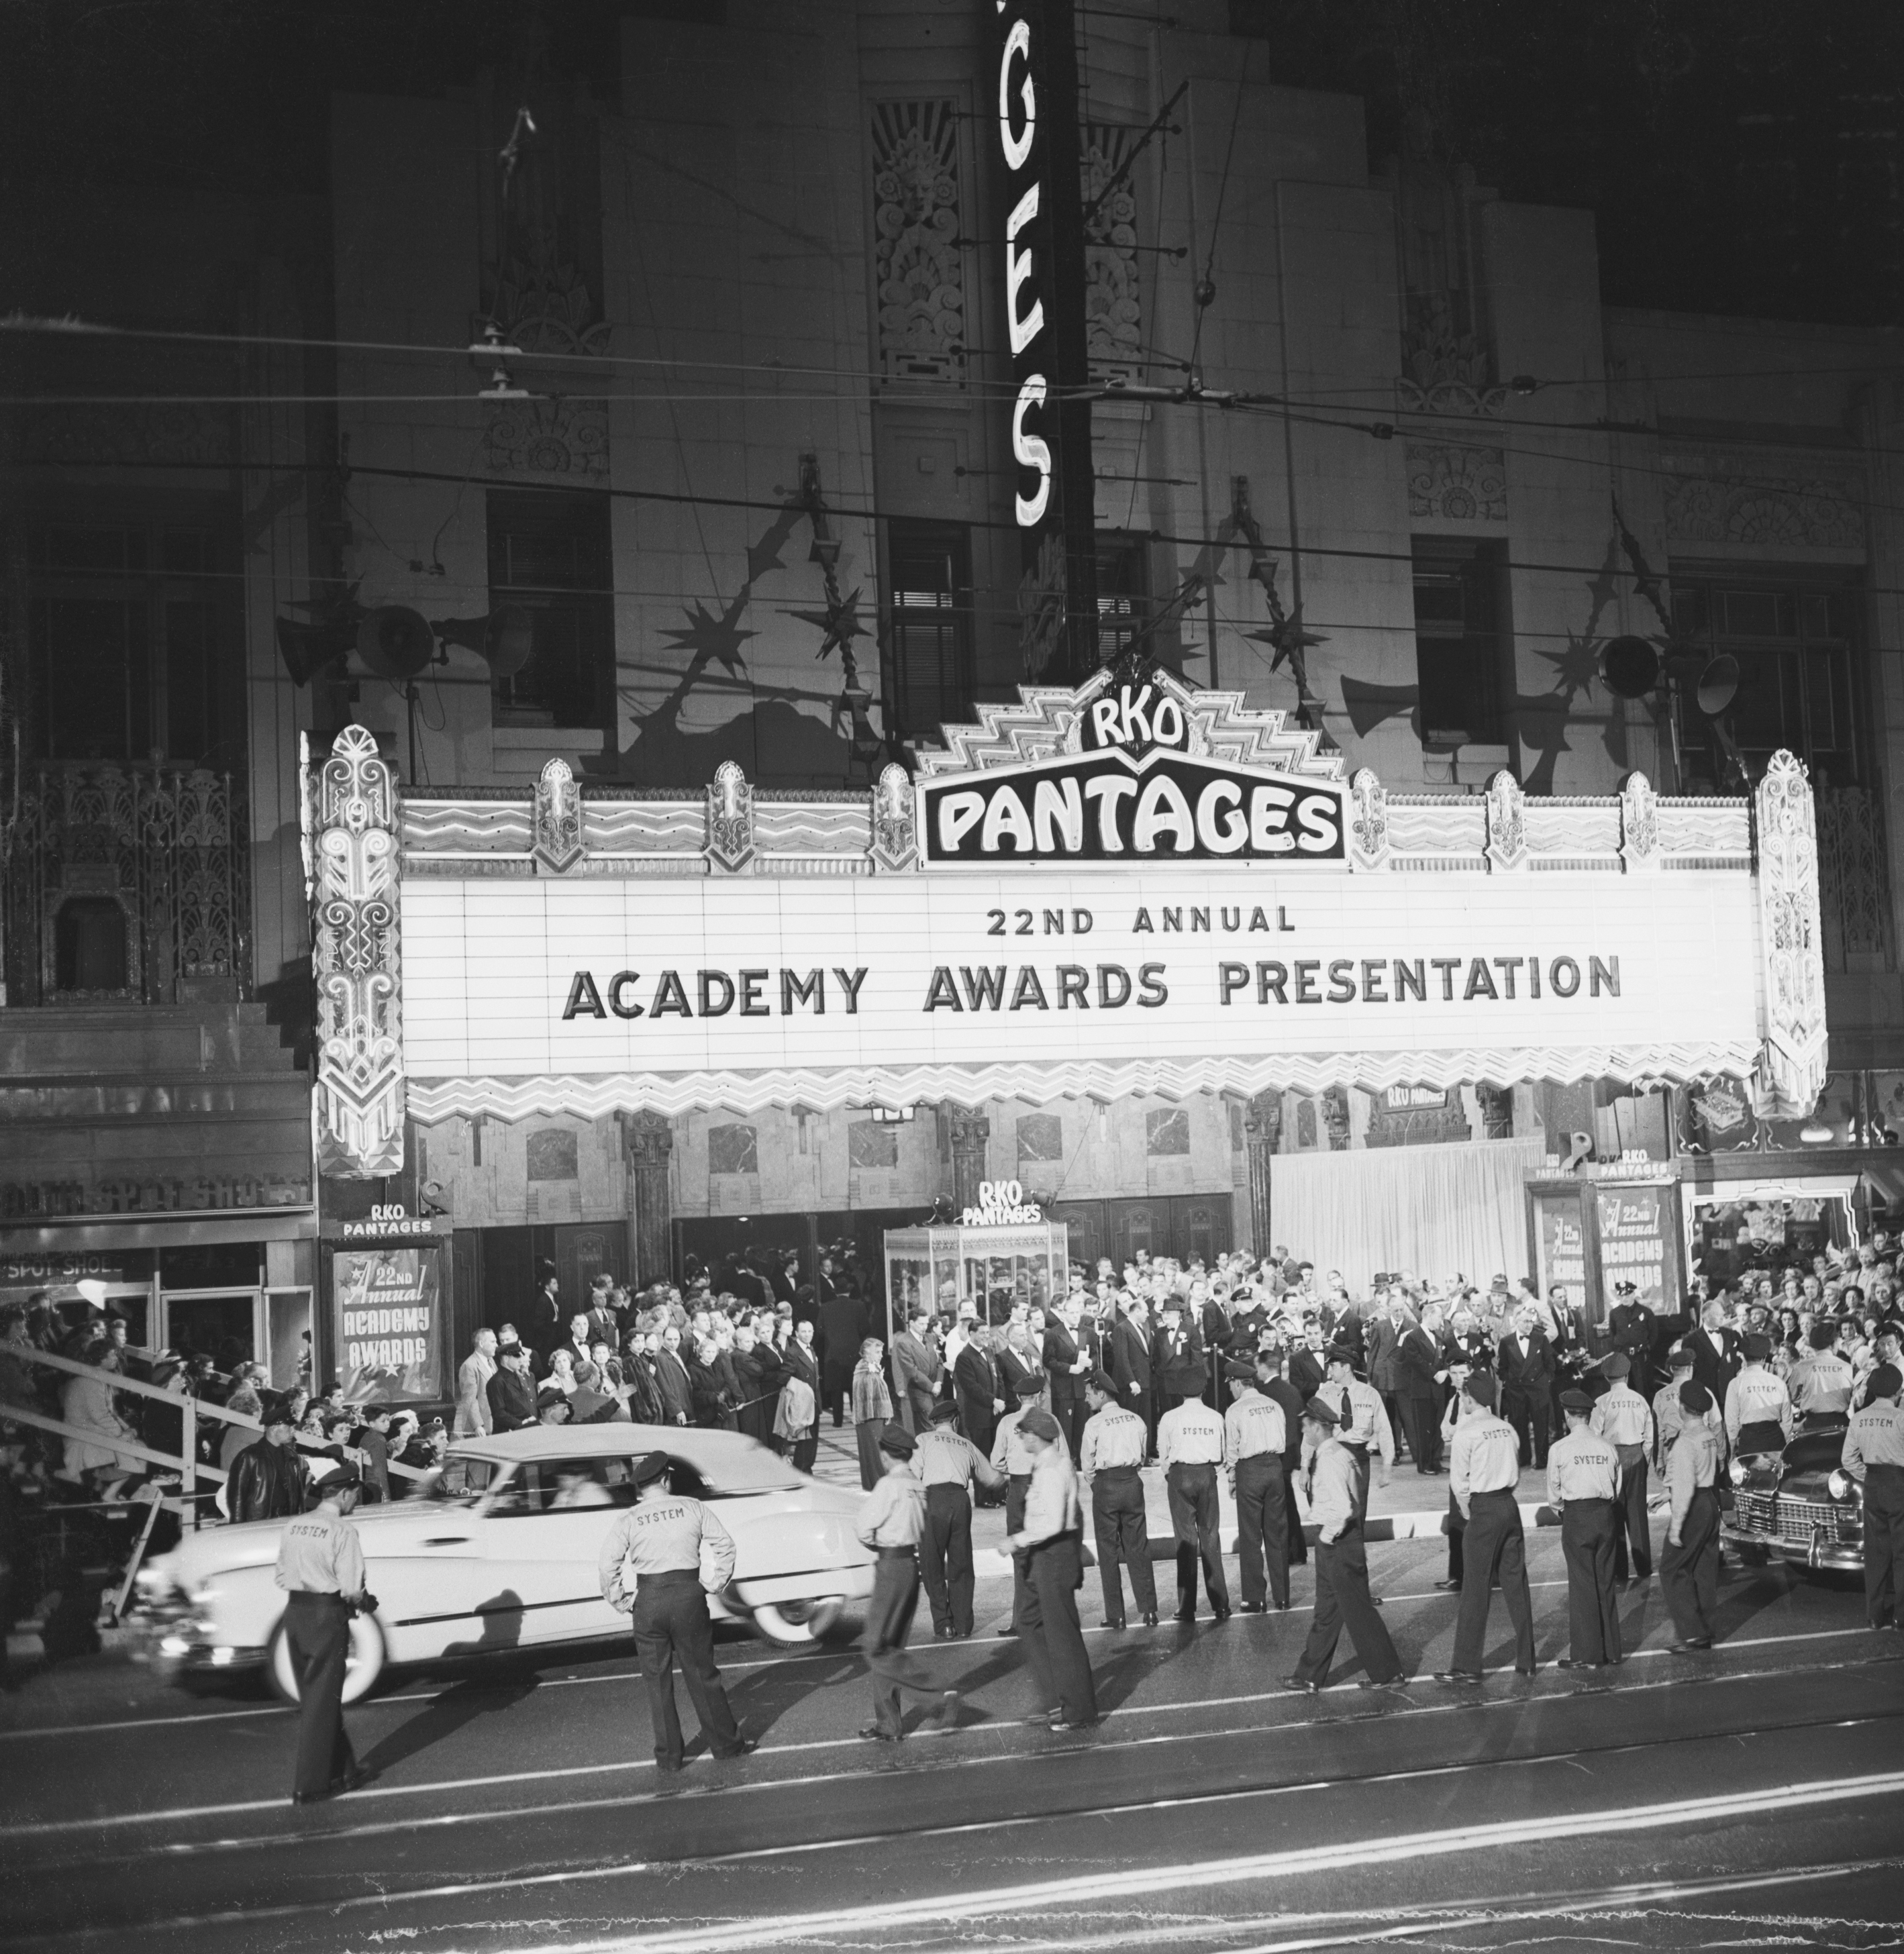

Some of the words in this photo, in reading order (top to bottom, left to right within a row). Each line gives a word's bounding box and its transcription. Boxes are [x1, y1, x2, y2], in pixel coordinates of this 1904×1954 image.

[997, 0, 1052, 527] GES
[1093, 685, 1183, 746] RKO
[940, 775, 1338, 853] PANTAGES
[987, 907, 1093, 935] 22ND
[1132, 906, 1295, 933] ANNUAL
[562, 968, 868, 1020] ACADEMY
[923, 962, 1168, 1012] AWARDS
[1219, 955, 1621, 1005] PRESENTATION
[1622, 1149, 1648, 1165] RKO
[1601, 1162, 1668, 1177] PANTAGES
[193, 1172, 307, 1209] SHOES
[979, 1180, 1022, 1208] RKO
[371, 1204, 405, 1221] RKO
[962, 1204, 1042, 1226] PANTAGES
[1602, 1199, 1660, 1237] Annual
[1623, 1206, 1650, 1222] 22ND
[344, 1221, 432, 1235] PANTAGES
[1601, 1239, 1664, 1264] ACADEMY
[8, 1260, 54, 1278] SPOT
[375, 1267, 413, 1286] 22ND
[1605, 1265, 1662, 1289] AWARDS
[344, 1260, 427, 1304] Annual
[344, 1307, 430, 1336] ACADEMY
[349, 1337, 427, 1367] AWARDS
[1812, 1365, 1843, 1373] SYSTEM
[1746, 1386, 1776, 1394] SYSTEM
[1249, 1405, 1276, 1417] SYSTEM
[1611, 1400, 1642, 1409] SYSTEM
[1105, 1415, 1136, 1426] SYSTEM
[1859, 1418, 1893, 1428] SYSTEM
[1183, 1427, 1214, 1435] SYSTEM
[934, 1435, 967, 1447] SYSTEM
[1574, 1455, 1609, 1465] SYSTEM
[637, 1508, 684, 1526] SYSTEM
[290, 1525, 329, 1539] SYSTEM
